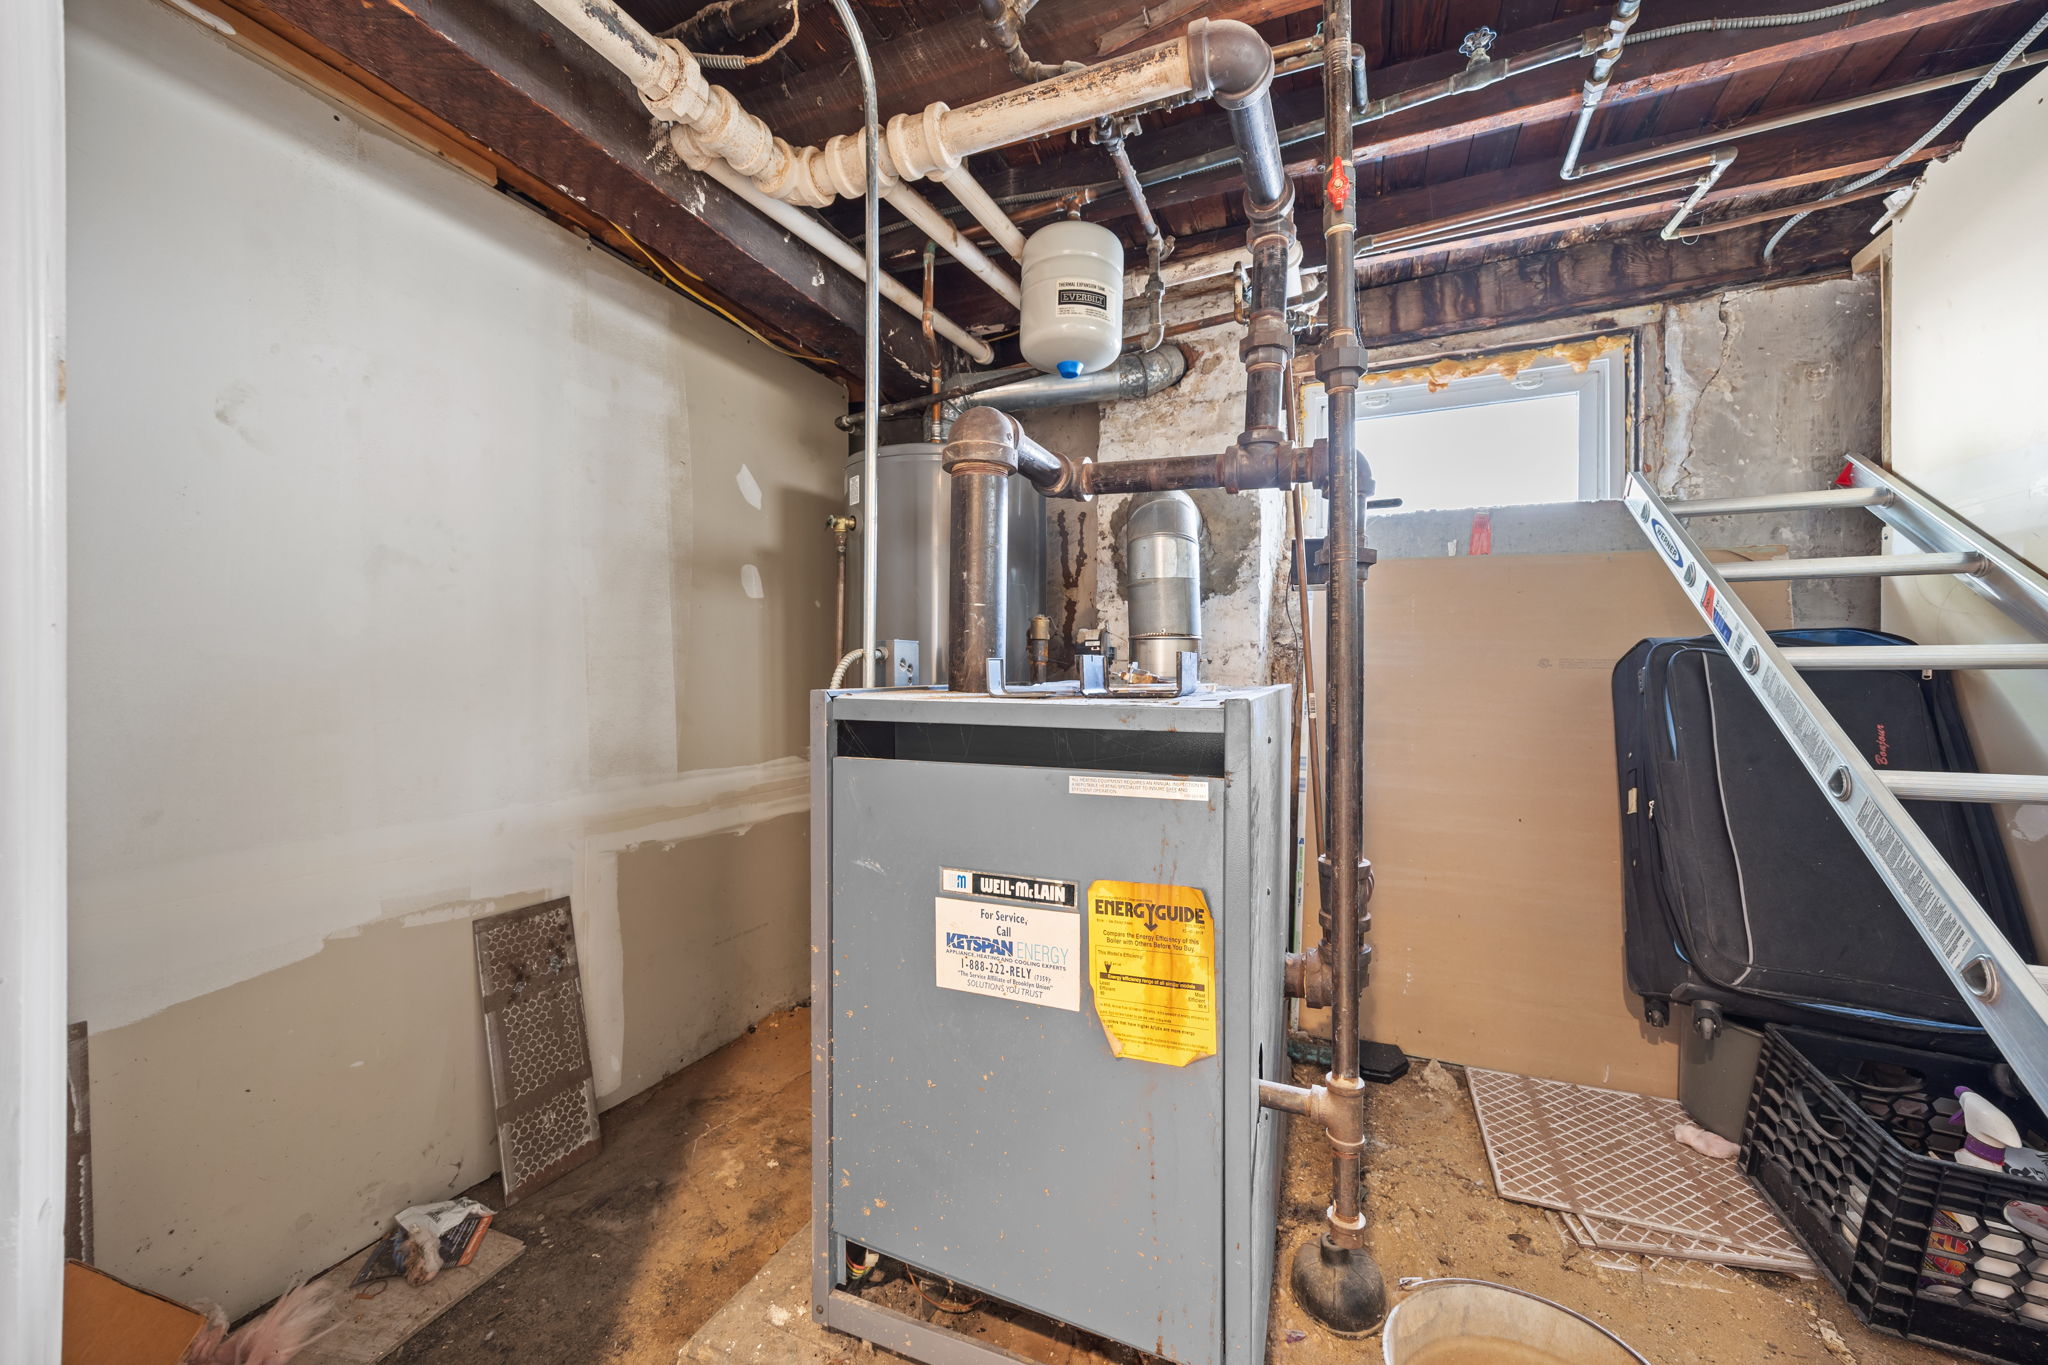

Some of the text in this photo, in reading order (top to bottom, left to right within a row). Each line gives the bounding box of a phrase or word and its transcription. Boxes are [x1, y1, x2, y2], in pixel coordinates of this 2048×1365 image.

[1063, 294, 1103, 304] EVERBILT
[1656, 526, 1678, 559] WERNER
[1875, 724, 1890, 765] Bonjour
[980, 908, 994, 920] For
[1095, 899, 1205, 924] ENERGYGUIDE
[996, 926, 1011, 937] Call
[1136, 932, 1155, 941] Energy
[1155, 934, 1181, 944] Efficiency
[946, 932, 1069, 965] KEYSPAN ENERGY
[1135, 939, 1152, 947] Others
[1154, 941, 1171, 950] Before
[961, 958, 1031, 979] 1-888-222-RELY
[977, 953, 1000, 961] HEATING
[1014, 959, 1040, 967] COOLING
[1042, 963, 1066, 971] EXPERTS
[967, 979, 1043, 998] SOLUTIONS YOU TRUST
[970, 972, 986, 980] Service
[987, 973, 1006, 983] Affiliate
[1013, 979, 1035, 989] Brooklyn
